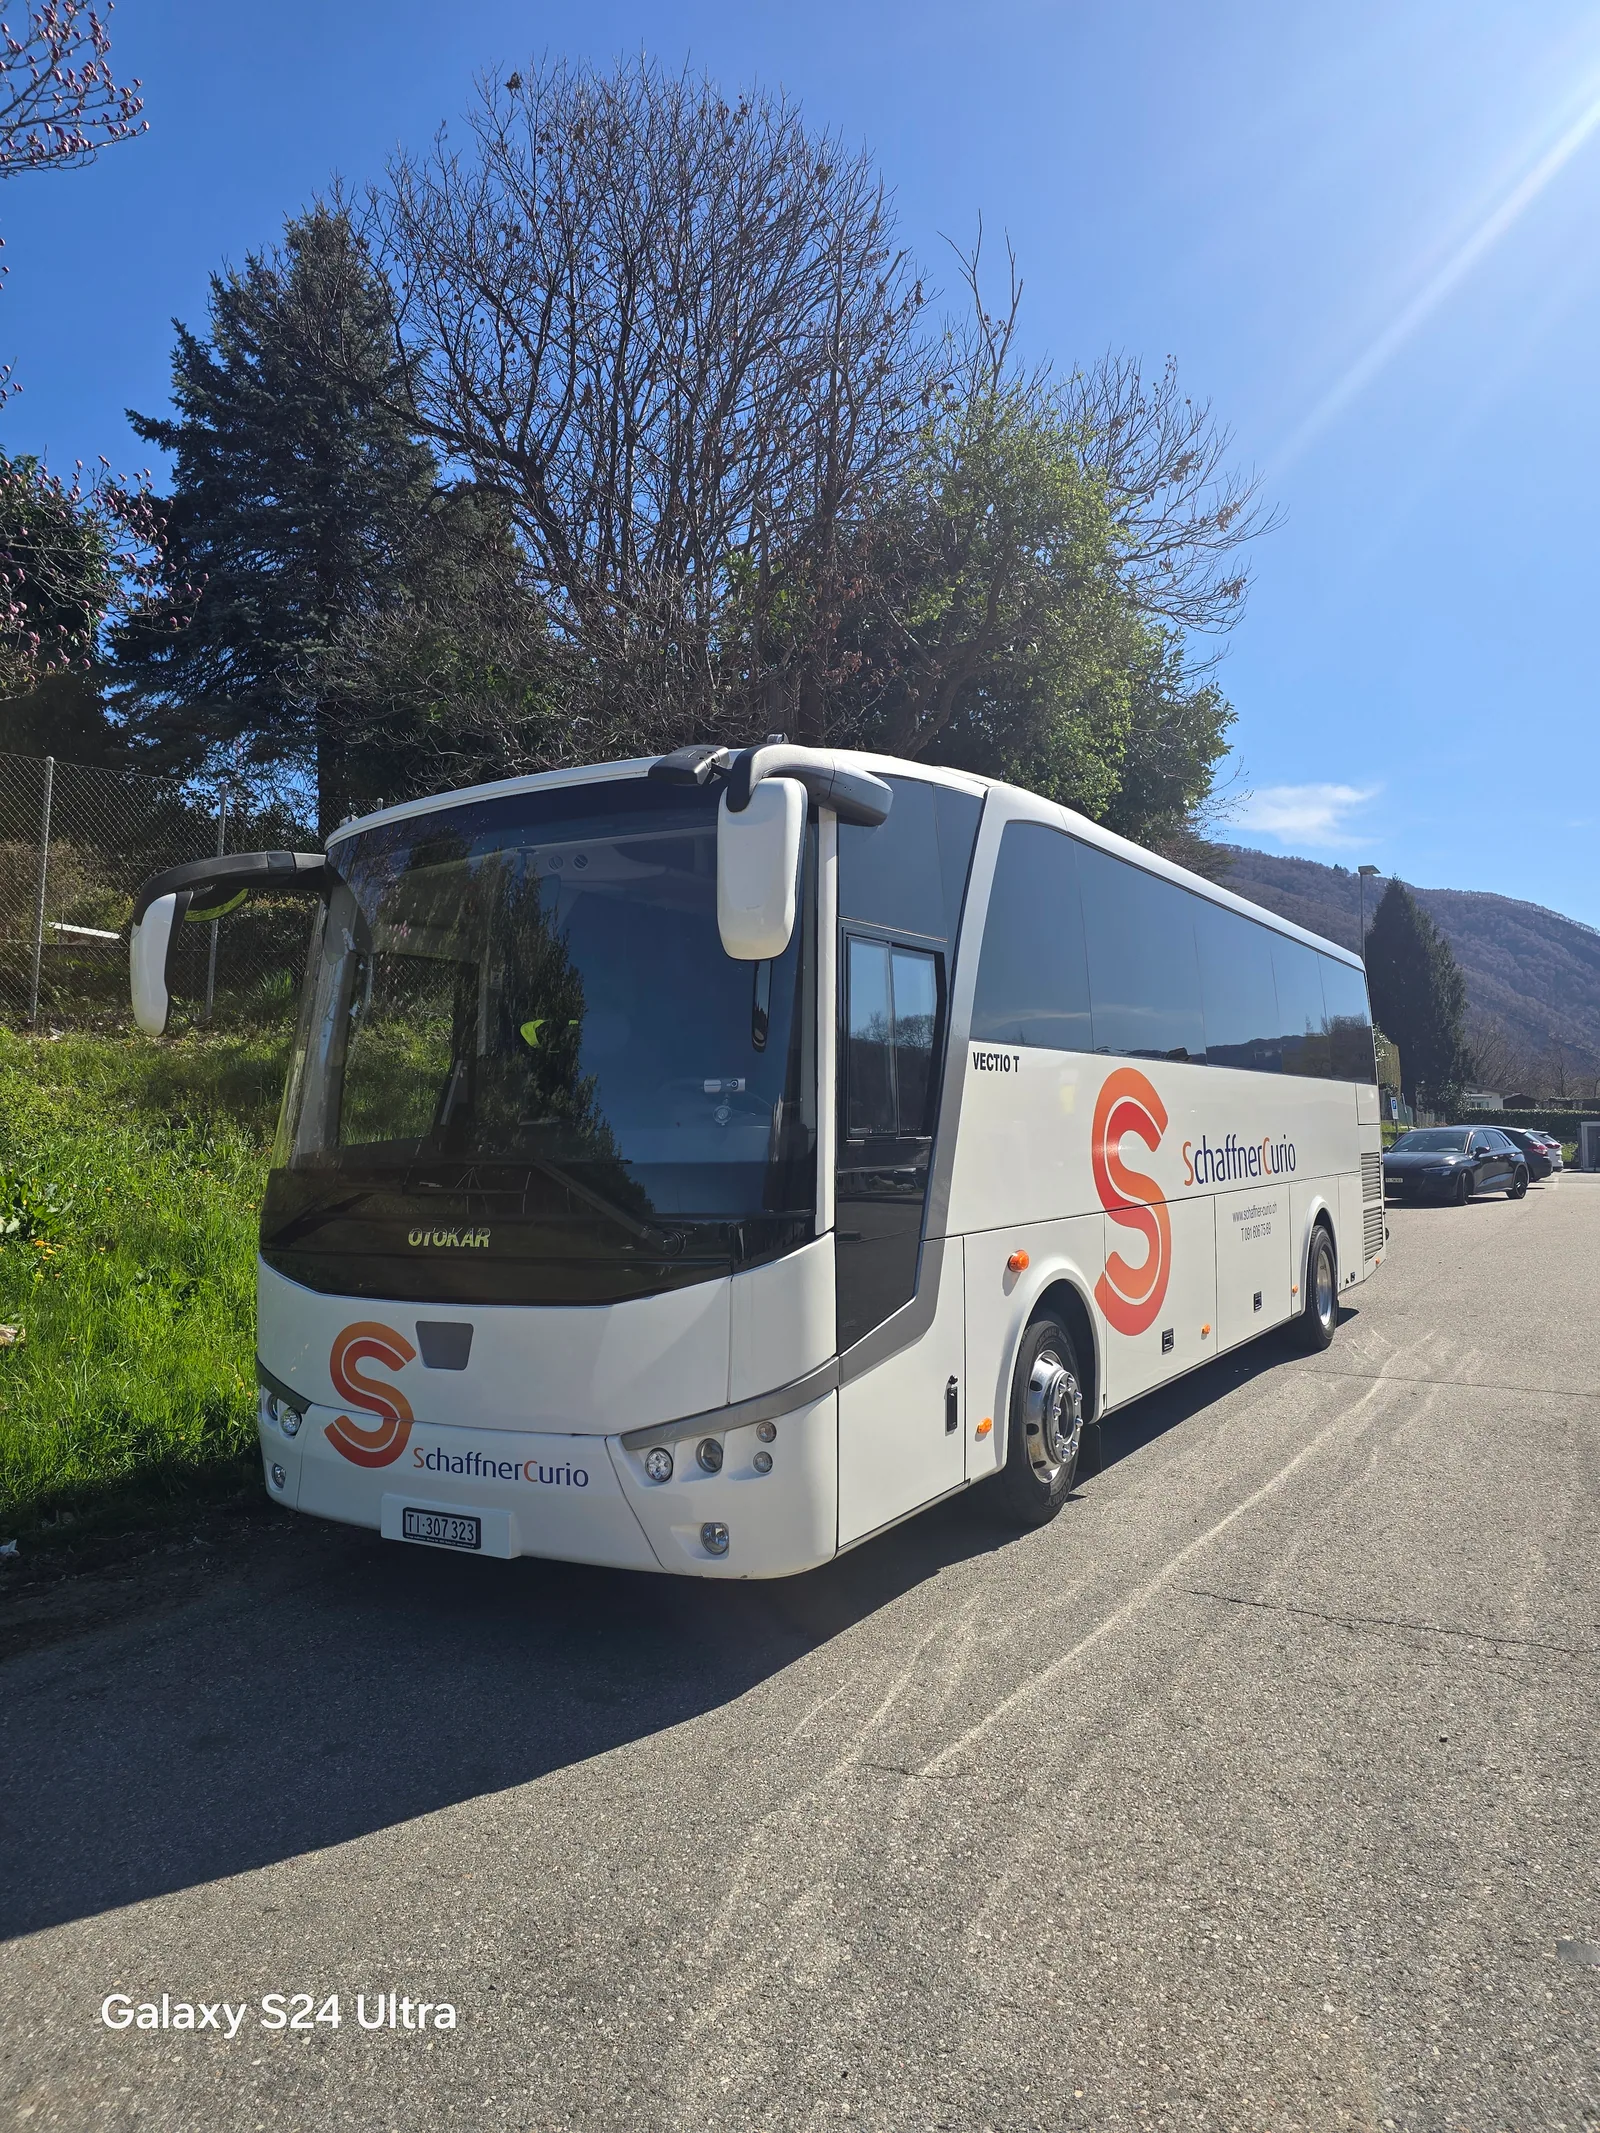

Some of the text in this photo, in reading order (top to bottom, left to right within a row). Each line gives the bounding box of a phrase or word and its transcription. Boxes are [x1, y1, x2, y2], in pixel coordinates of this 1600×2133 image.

[973, 1052, 1020, 1072] VECTIO T
[1182, 1133, 1296, 1187] SchaffnerCurio
[408, 1227, 491, 1248] OTOKAR
[413, 1447, 589, 1487] SchaffnerCurio
